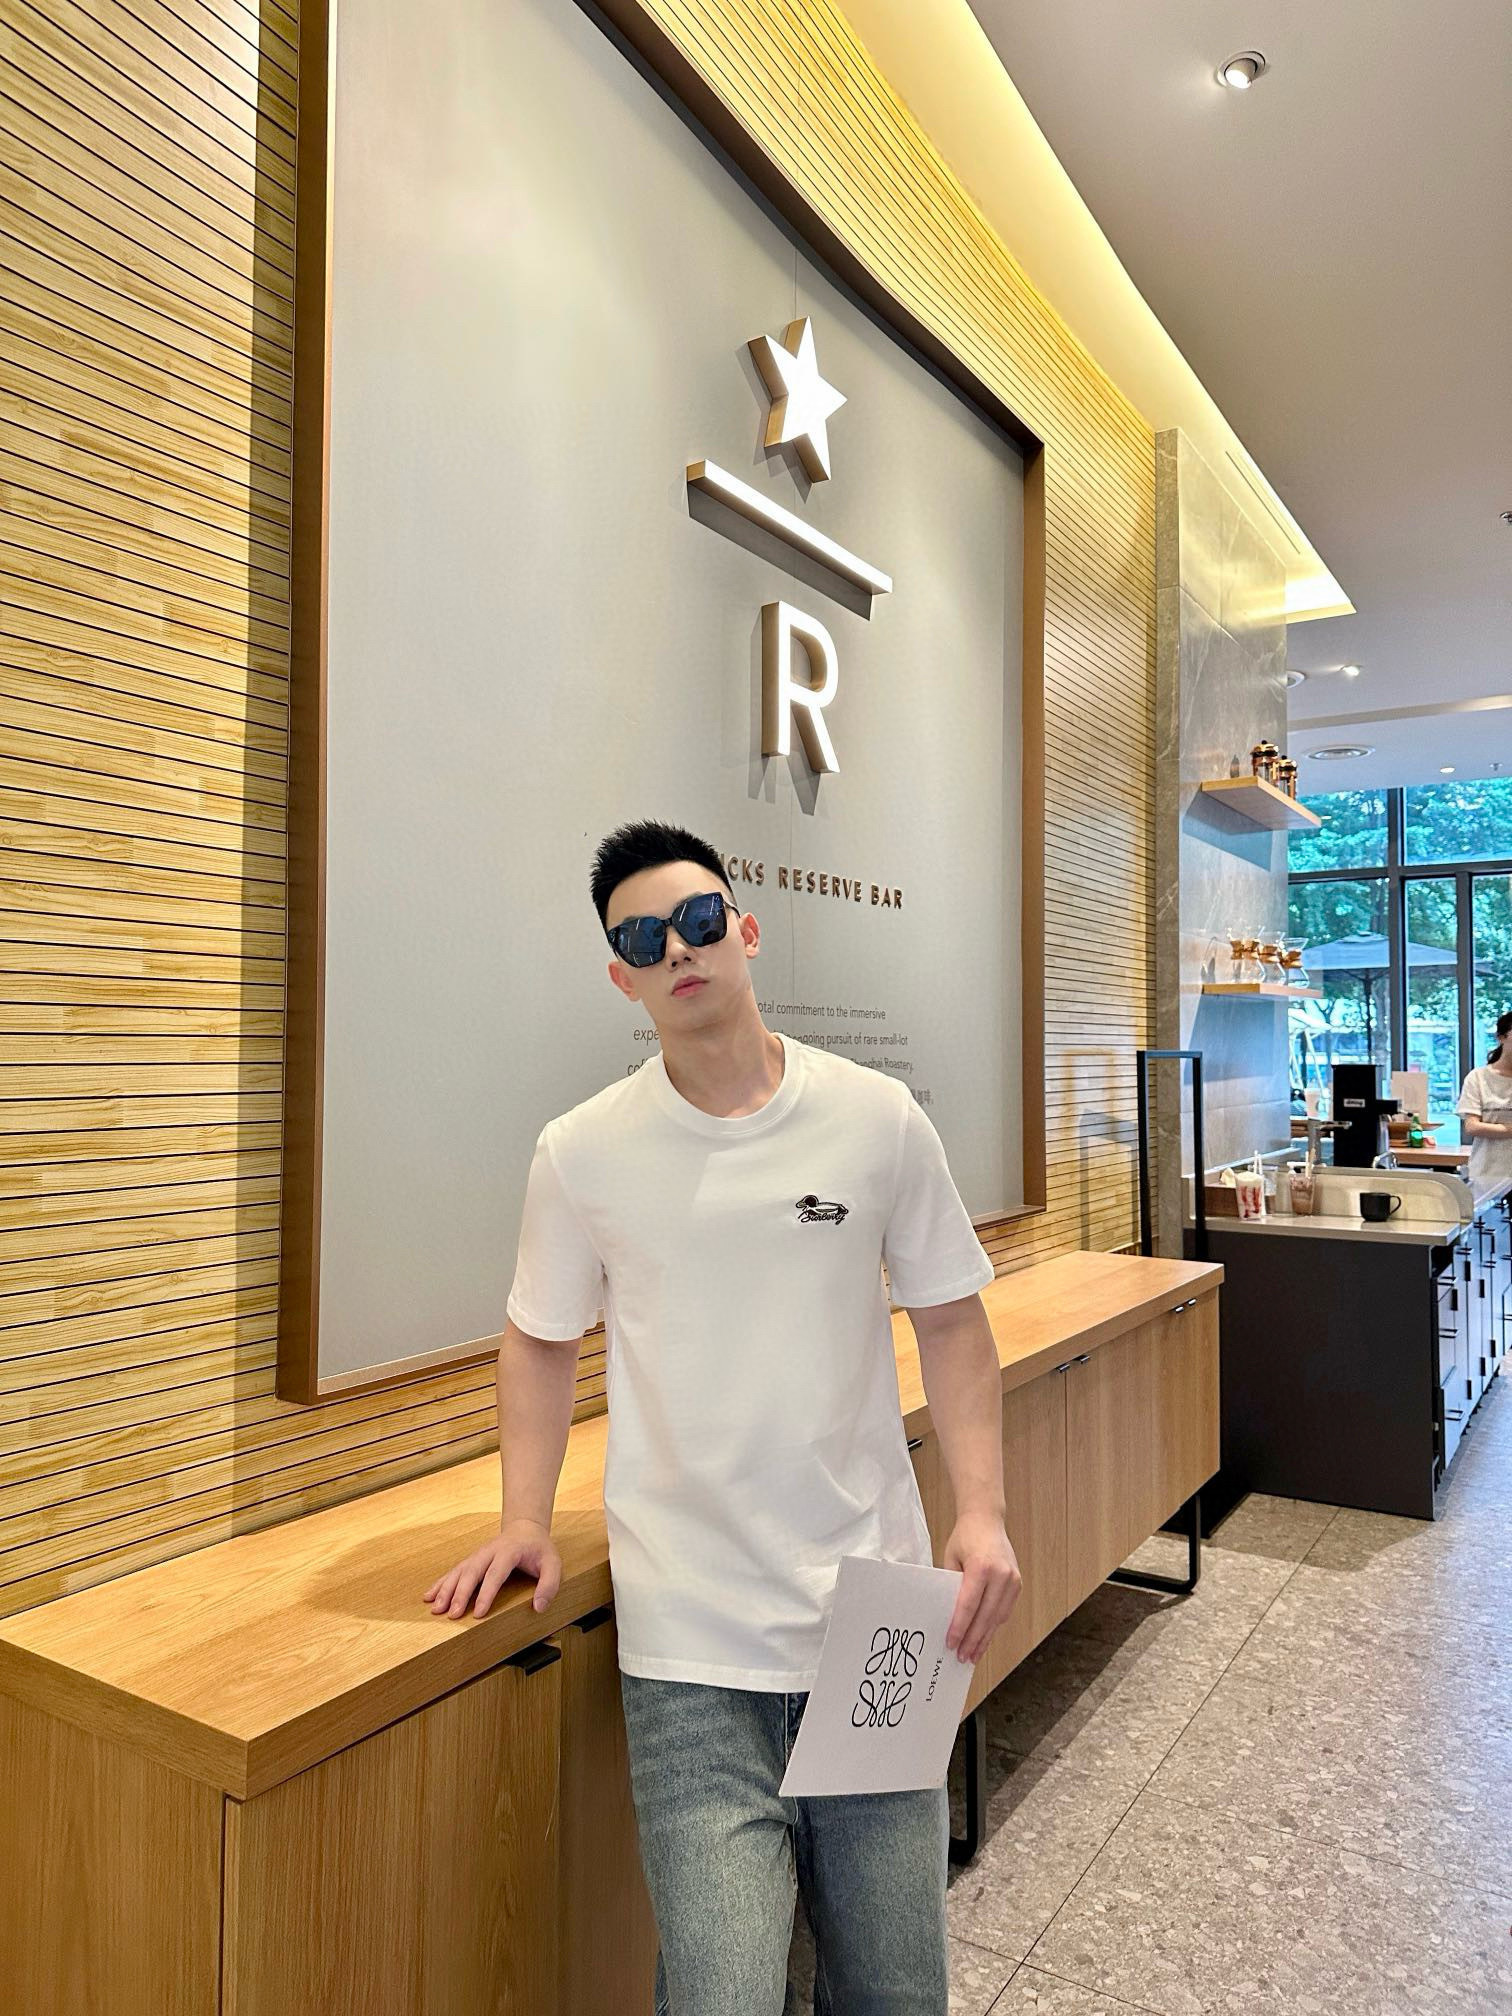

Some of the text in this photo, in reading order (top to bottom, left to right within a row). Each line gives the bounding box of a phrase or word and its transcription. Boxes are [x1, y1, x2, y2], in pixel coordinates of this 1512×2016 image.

[762, 601, 840, 774] R
[778, 865, 862, 902] RESERVE
[871, 884, 903, 909] BAR
[776, 1002, 825, 1017] commitment
[827, 1006, 835, 1017] to
[836, 1004, 848, 1018] the
[850, 1006, 886, 1020] immersive
[826, 1032, 853, 1048] pursuit
[854, 1032, 862, 1045] of
[863, 1035, 878, 1046] rare
[925, 1656, 944, 1702] LOEWE
